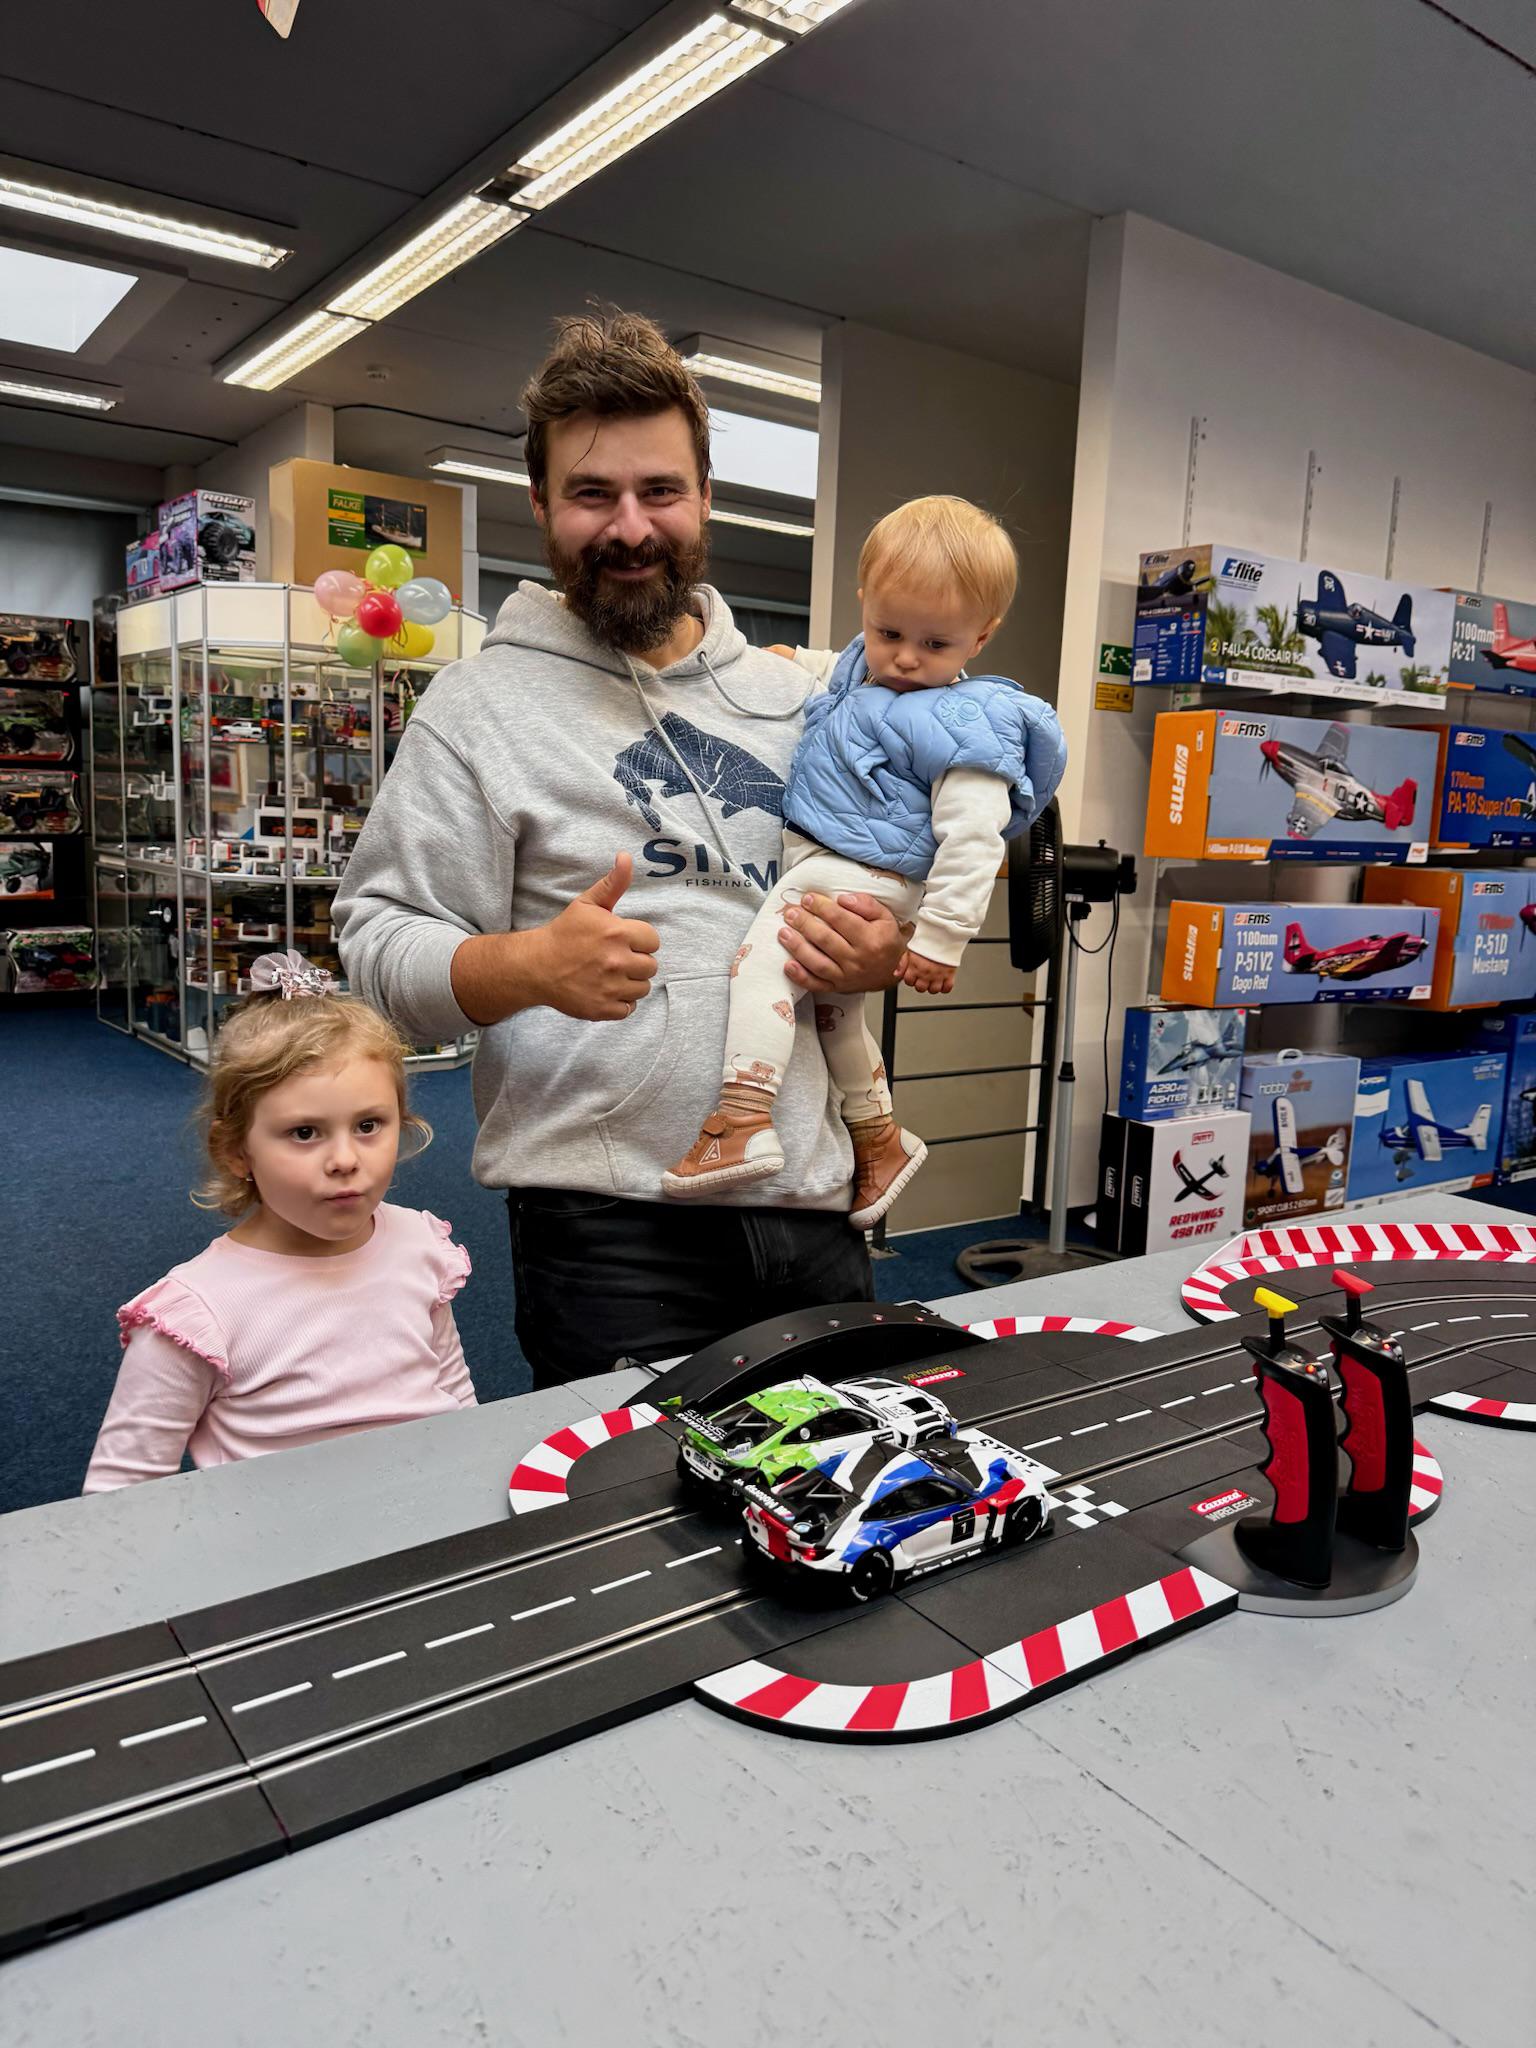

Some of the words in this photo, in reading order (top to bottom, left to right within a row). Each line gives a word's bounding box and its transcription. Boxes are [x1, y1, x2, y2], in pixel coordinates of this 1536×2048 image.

[202, 493, 251, 507] ROGUE
[333, 498, 361, 511] FALKE
[1455, 620, 1495, 643] 1100mm
[1221, 642, 1250, 658] F4U-4
[1251, 647, 1291, 664] CORSAIR
[1452, 641, 1476, 661] PC-21
[1448, 791, 1476, 814] PA-18
[1477, 796, 1504, 819] Super
[686, 878, 752, 888] FISHING
[1236, 931, 1278, 946] 1100mm
[1474, 934, 1508, 956] P-51D
[1472, 957, 1510, 976] Mustang
[1232, 975, 1252, 994] Dago
[1253, 975, 1270, 989] Red
[1169, 1206, 1224, 1227] REDWINGS
[1257, 1204, 1276, 1216] SPORT
[1276, 1202, 1288, 1212] CUB
[1194, 1221, 1217, 1236] RTF
[915, 1370, 959, 1385] Carrera
[1197, 1490, 1243, 1512] Carrera
[961, 1522, 968, 1534] 1
